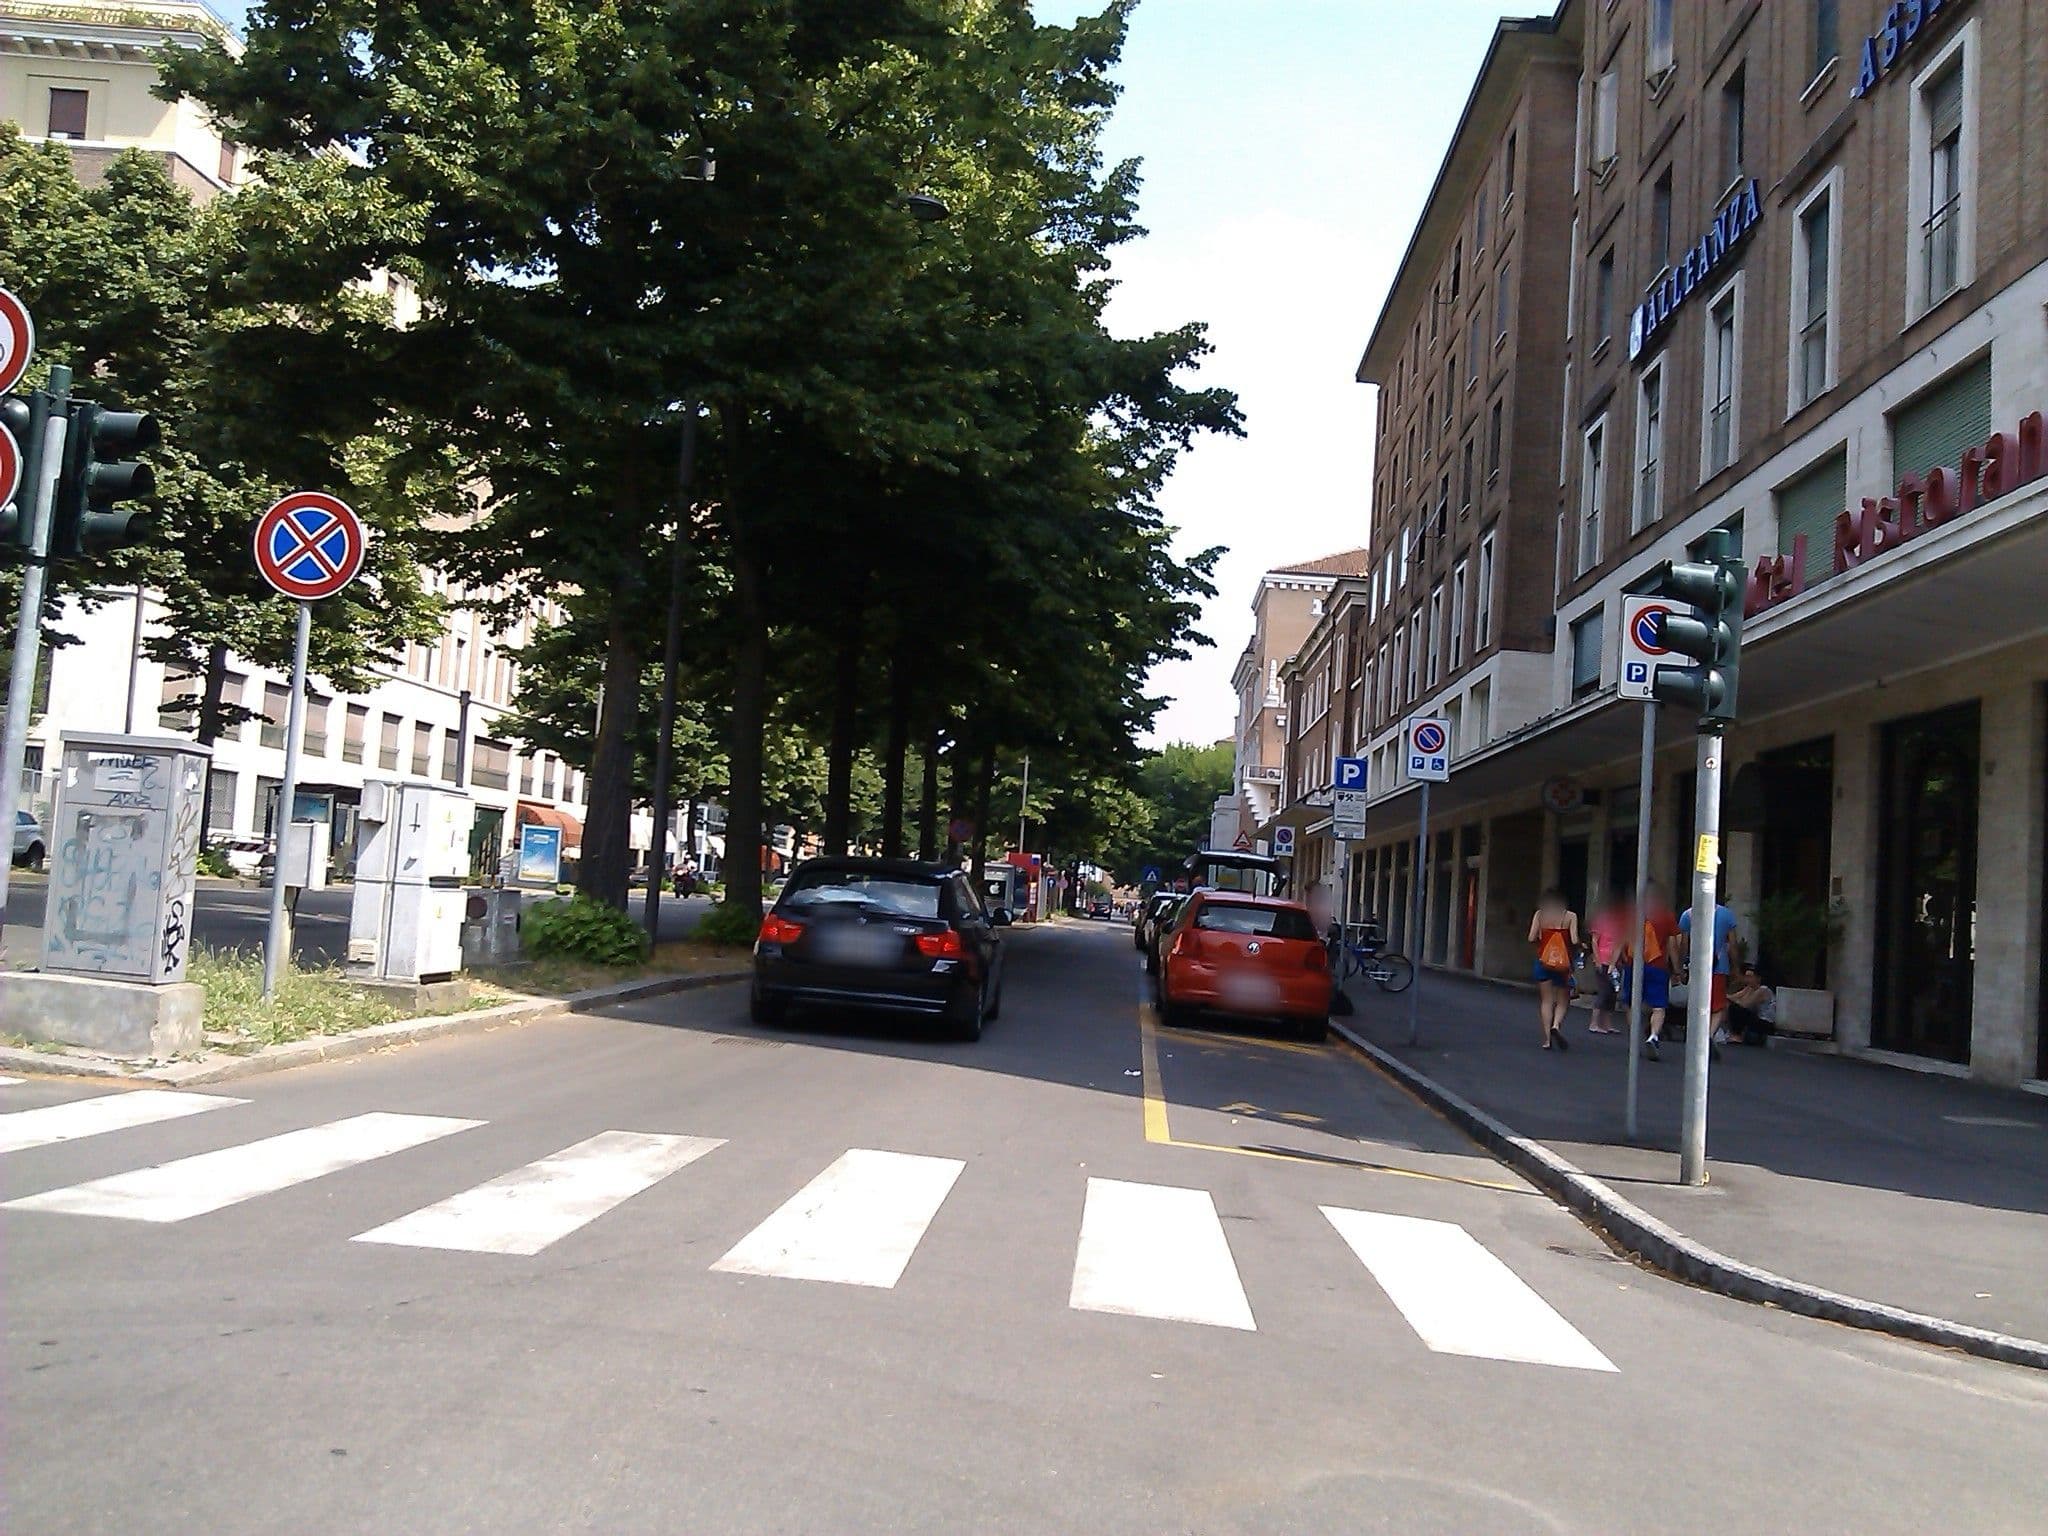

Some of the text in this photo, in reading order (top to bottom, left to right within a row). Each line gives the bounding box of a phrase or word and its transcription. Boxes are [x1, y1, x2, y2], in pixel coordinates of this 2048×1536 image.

[1850, 0, 1943, 99] ASS
[1646, 179, 1762, 336] ALLEANZA
[1632, 665, 1645, 680] P
[1342, 763, 1361, 784] P
